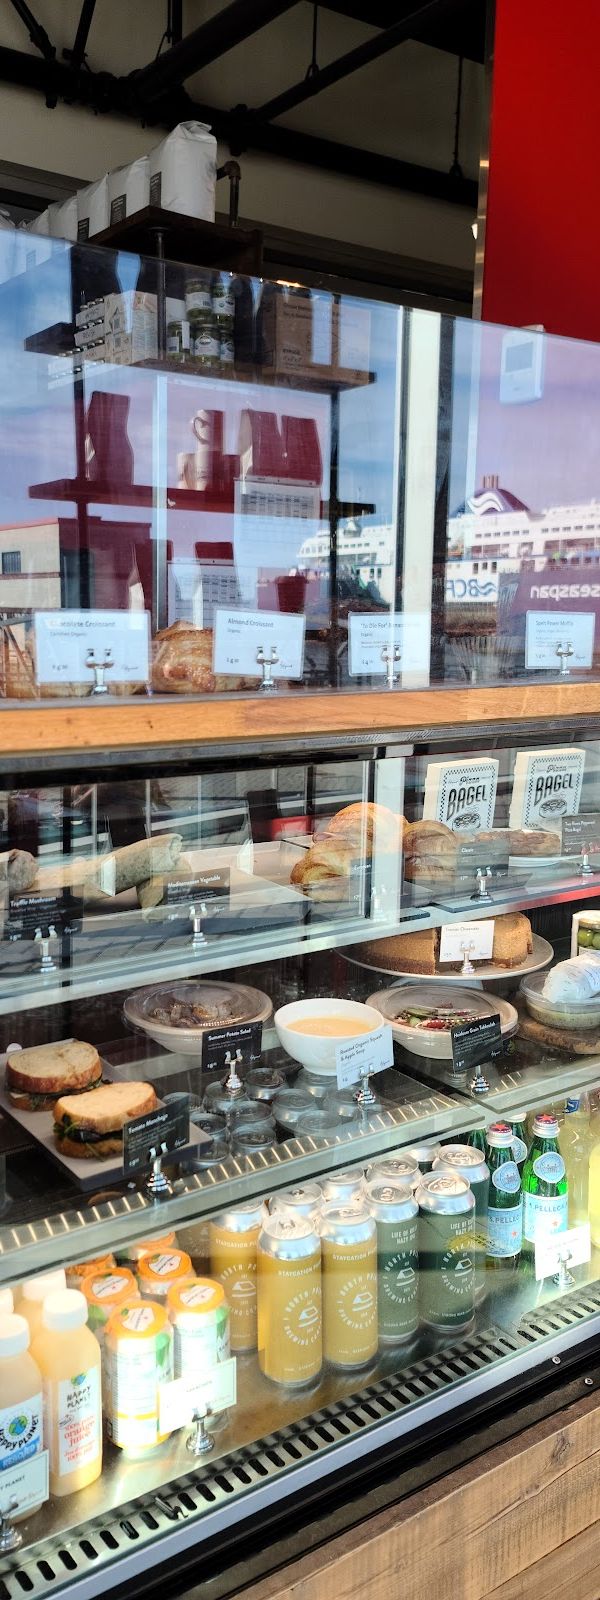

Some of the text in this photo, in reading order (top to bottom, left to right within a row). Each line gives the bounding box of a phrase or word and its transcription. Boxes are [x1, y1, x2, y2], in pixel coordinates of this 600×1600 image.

[228, 617, 249, 626] Almond
[534, 773, 574, 807] BAGEL
[446, 785, 487, 821] BAGEL
[10, 896, 57, 908] Truffle Mushroom
[208, 1033, 226, 1041] Summer
[240, 1027, 251, 1035] Salad
[469, 1026, 480, 1035] Grain
[391, 1231, 402, 1239] LIFE
[332, 1252, 368, 1261] STAYCATION
[442, 1242, 465, 1263] NORTH
[384, 1252, 406, 1272] NORTH
[278, 1264, 313, 1277] STAYCATION
[339, 1275, 363, 1297] NORTH
[284, 1289, 308, 1313] NORTH
[67, 1386, 91, 1401] HAPPY
